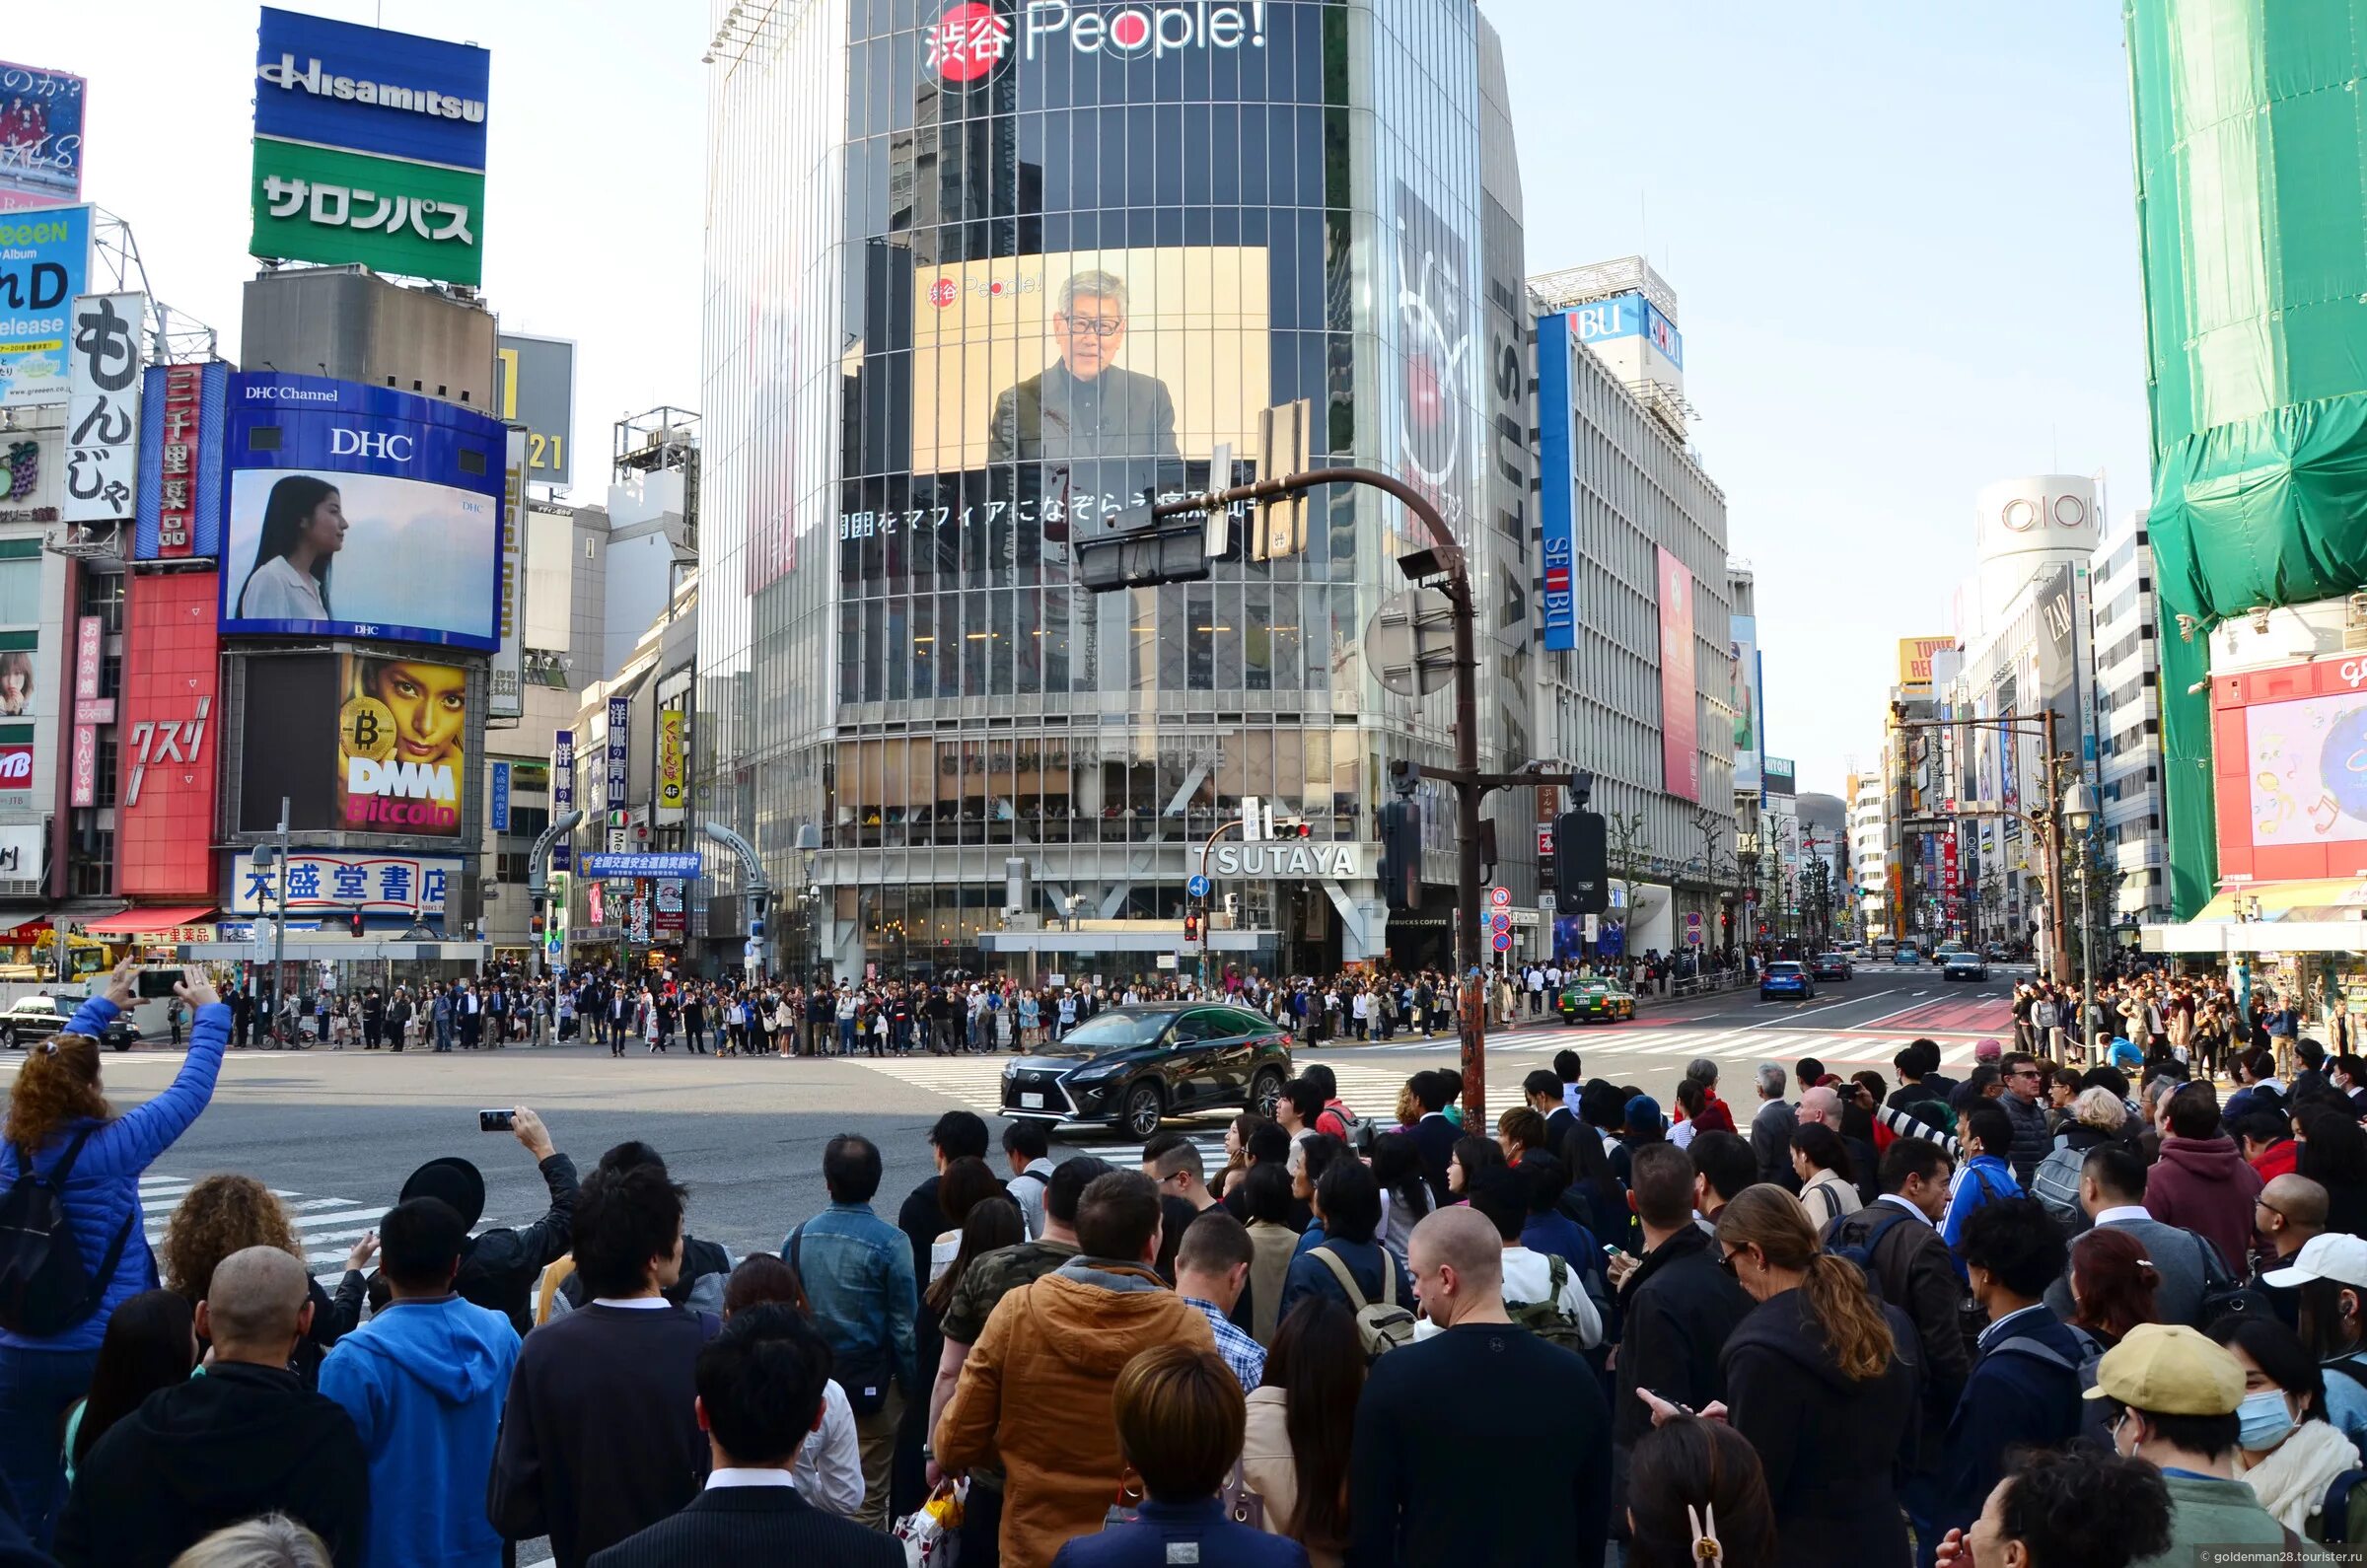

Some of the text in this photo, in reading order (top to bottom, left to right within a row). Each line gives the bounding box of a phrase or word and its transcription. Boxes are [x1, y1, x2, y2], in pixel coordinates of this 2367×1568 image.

[924, 0, 1265, 68] 渋谷 People!
[258, 52, 485, 123] Hisamitsu
[262, 175, 473, 246] サロンパス
[65, 298, 137, 514] もんじゃ
[246, 387, 338, 402] DHC Channel
[160, 370, 194, 546] 三千里薬品
[330, 428, 412, 462] DHC
[463, 501, 484, 514] DHC
[354, 624, 379, 635] DHC
[2044, 589, 2073, 643] ZAR
[607, 703, 626, 801] 洋服の青山
[1929, 728, 1941, 780] ARAOKE
[348, 756, 455, 801] DMM
[347, 795, 455, 826] Bitcoin
[594, 856, 698, 869] 全国交通安全運動実施中
[1193, 845, 1355, 875] TSUTAYA
[245, 863, 445, 902] 大盛堂書店
[632, 899, 642, 934] ラーメン
